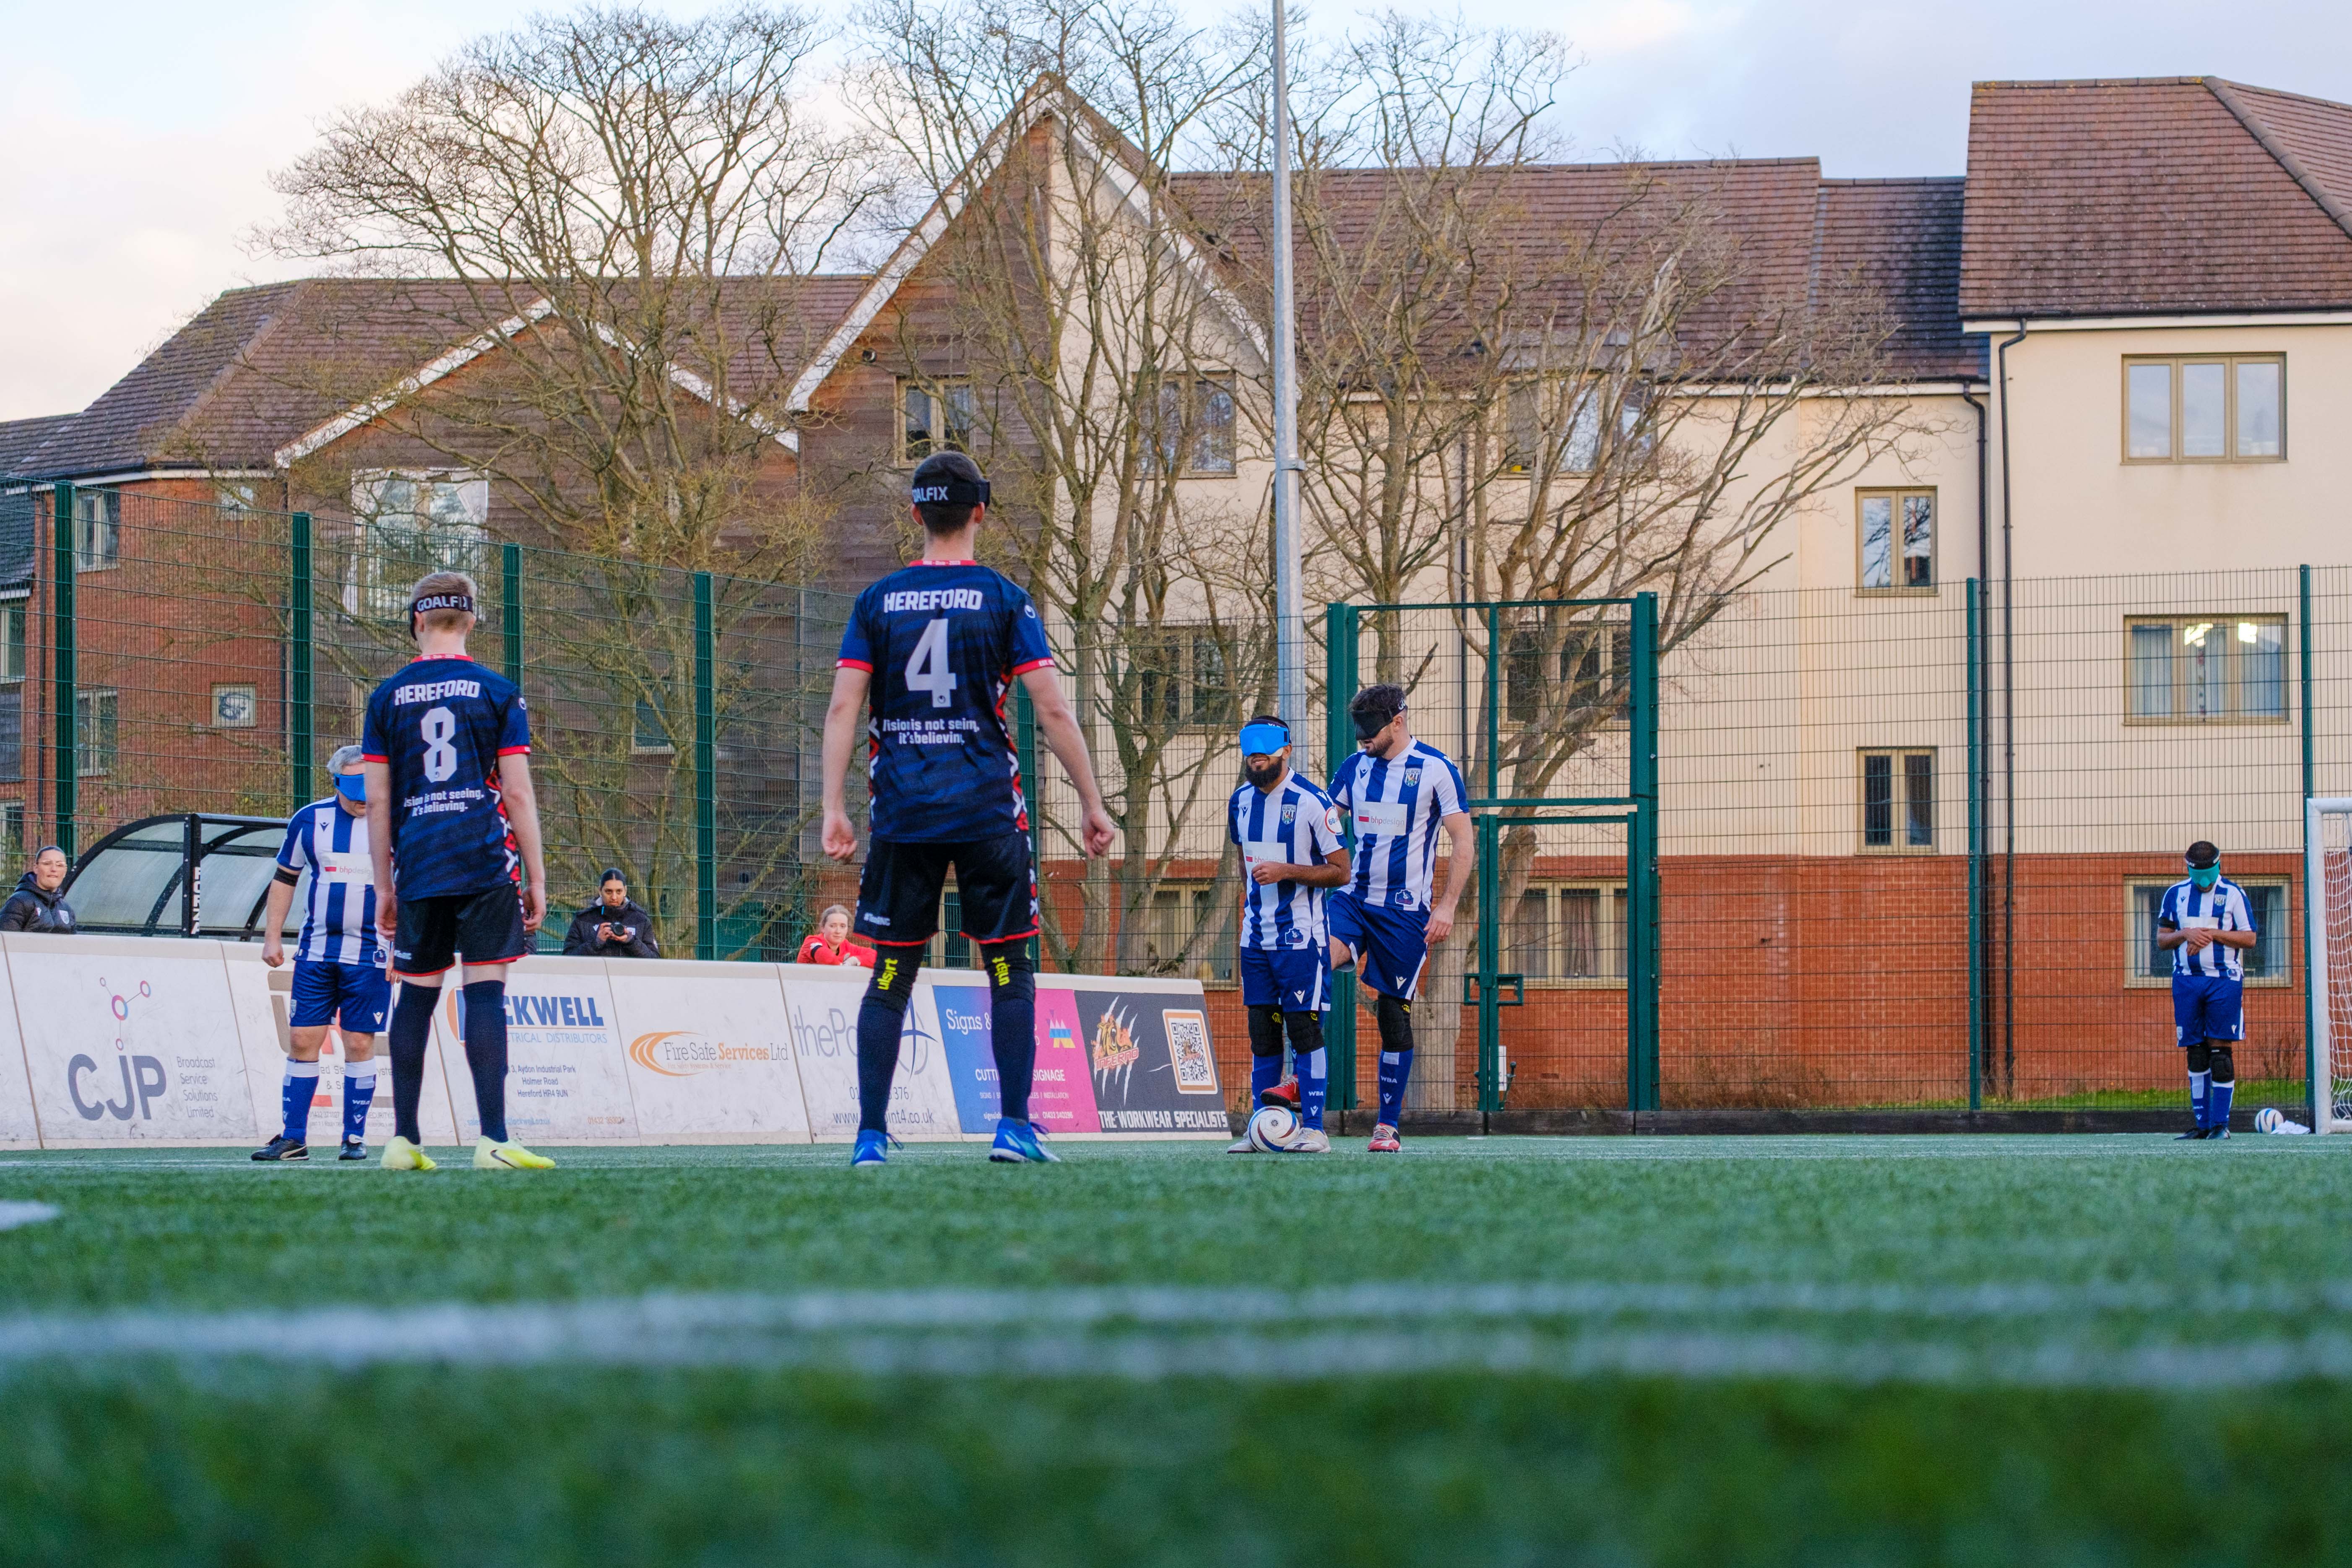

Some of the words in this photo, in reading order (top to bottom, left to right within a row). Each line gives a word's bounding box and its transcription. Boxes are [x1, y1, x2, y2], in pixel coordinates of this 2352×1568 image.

[884, 588, 983, 613] HEREFORD
[904, 618, 957, 707] 4
[394, 679, 481, 706] HEREFORD
[911, 718, 922, 731] is
[925, 718, 945, 731] not
[420, 706, 458, 783] 8
[431, 791, 447, 801] not
[1371, 816, 1405, 827] bhpdesign
[503, 996, 604, 1027] CKWELL
[945, 1008, 983, 1035] Signs
[546, 1032, 607, 1044] DISTRIBUTORS
[663, 1042, 689, 1060] Fire
[689, 1042, 716, 1061] Safe
[718, 1042, 770, 1061] Services
[770, 1043, 789, 1061] Ltd
[177, 1056, 216, 1068] Broadcast
[1095, 1047, 1139, 1071] INFERNO
[180, 1073, 208, 1085] Service
[975, 1069, 1000, 1081] CUTTI
[1033, 1069, 1066, 1082] SIGNAGE
[1380, 1075, 1398, 1084] WBA
[68, 1053, 167, 1121] CJP
[327, 1080, 333, 1090] &
[183, 1090, 218, 1102] Solutions
[517, 1089, 542, 1097] Hereford
[186, 1106, 215, 1118] Limited
[1098, 1110, 1117, 1129] THE
[1117, 1110, 1173, 1129] WORKWEAR
[1174, 1110, 1229, 1128] SPECIALISTS
